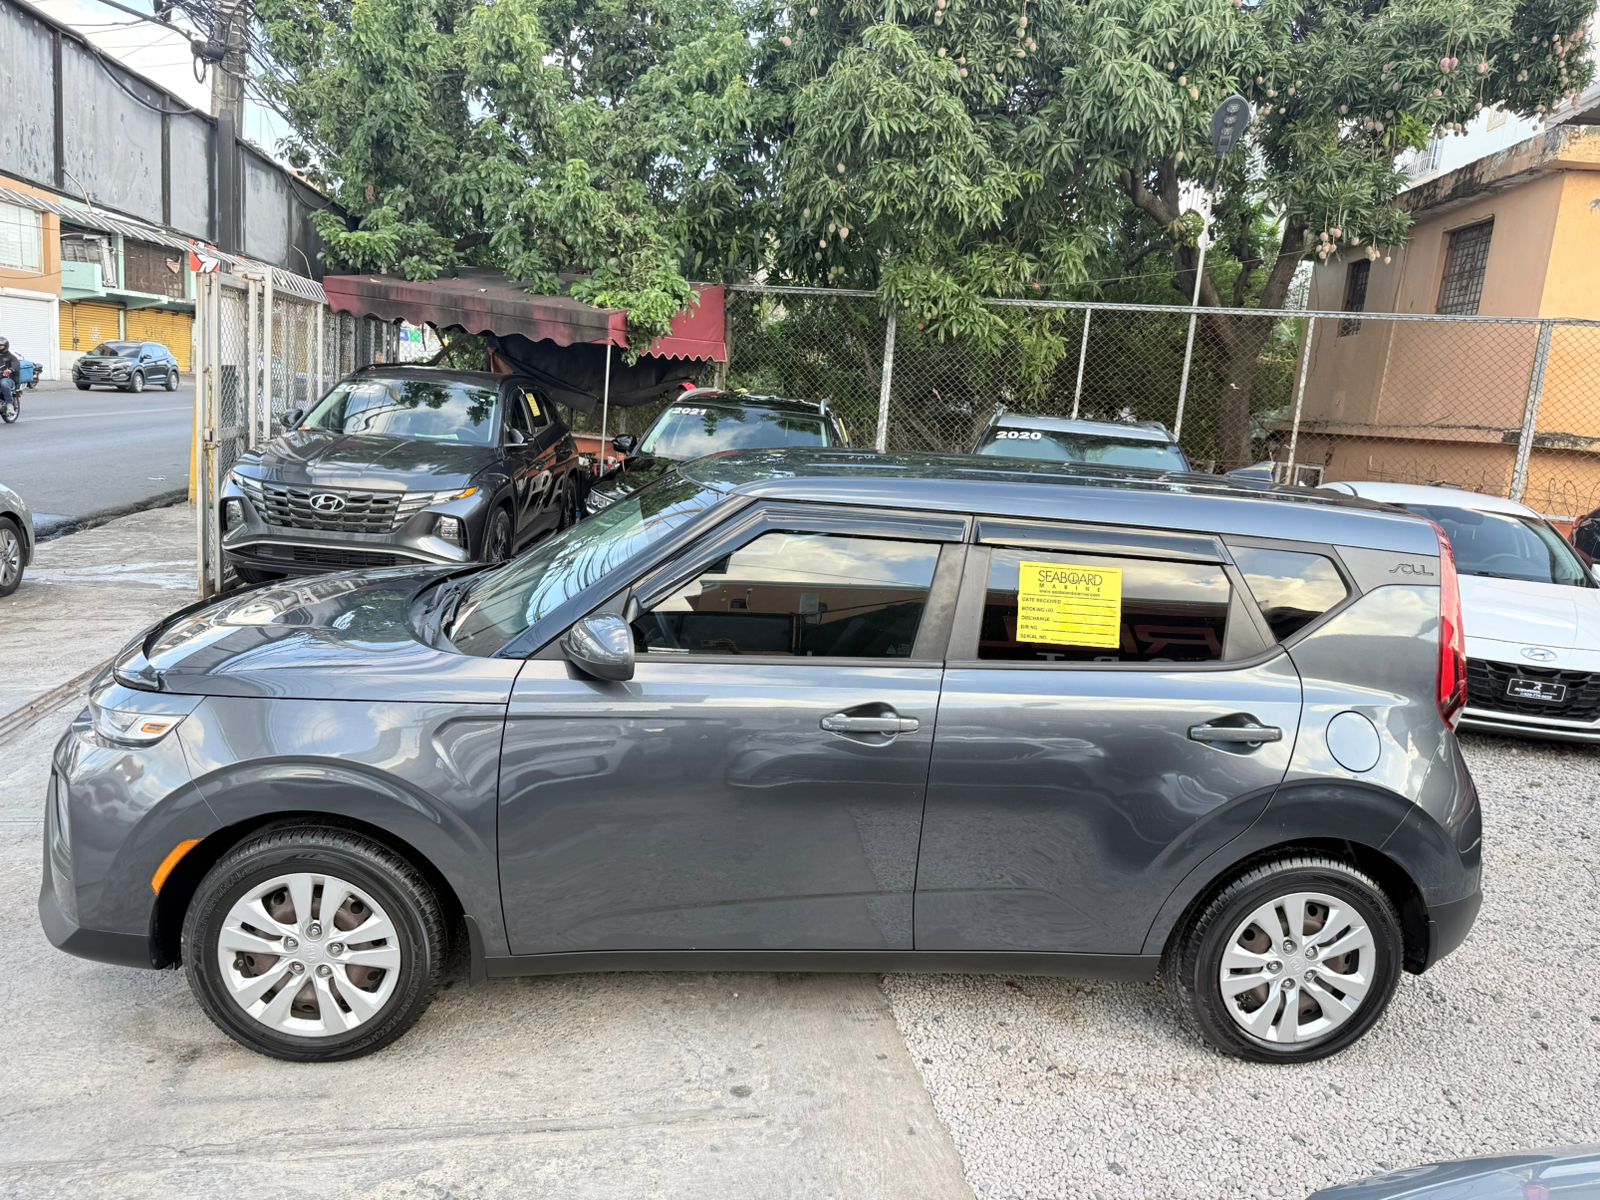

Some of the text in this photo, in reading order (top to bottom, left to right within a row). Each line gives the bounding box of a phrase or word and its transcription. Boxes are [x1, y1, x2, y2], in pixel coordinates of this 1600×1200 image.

[333, 384, 379, 393] 2022
[671, 407, 707, 416] 2021
[995, 430, 1042, 441] 2020
[1038, 570, 1103, 586] SEABOARD
